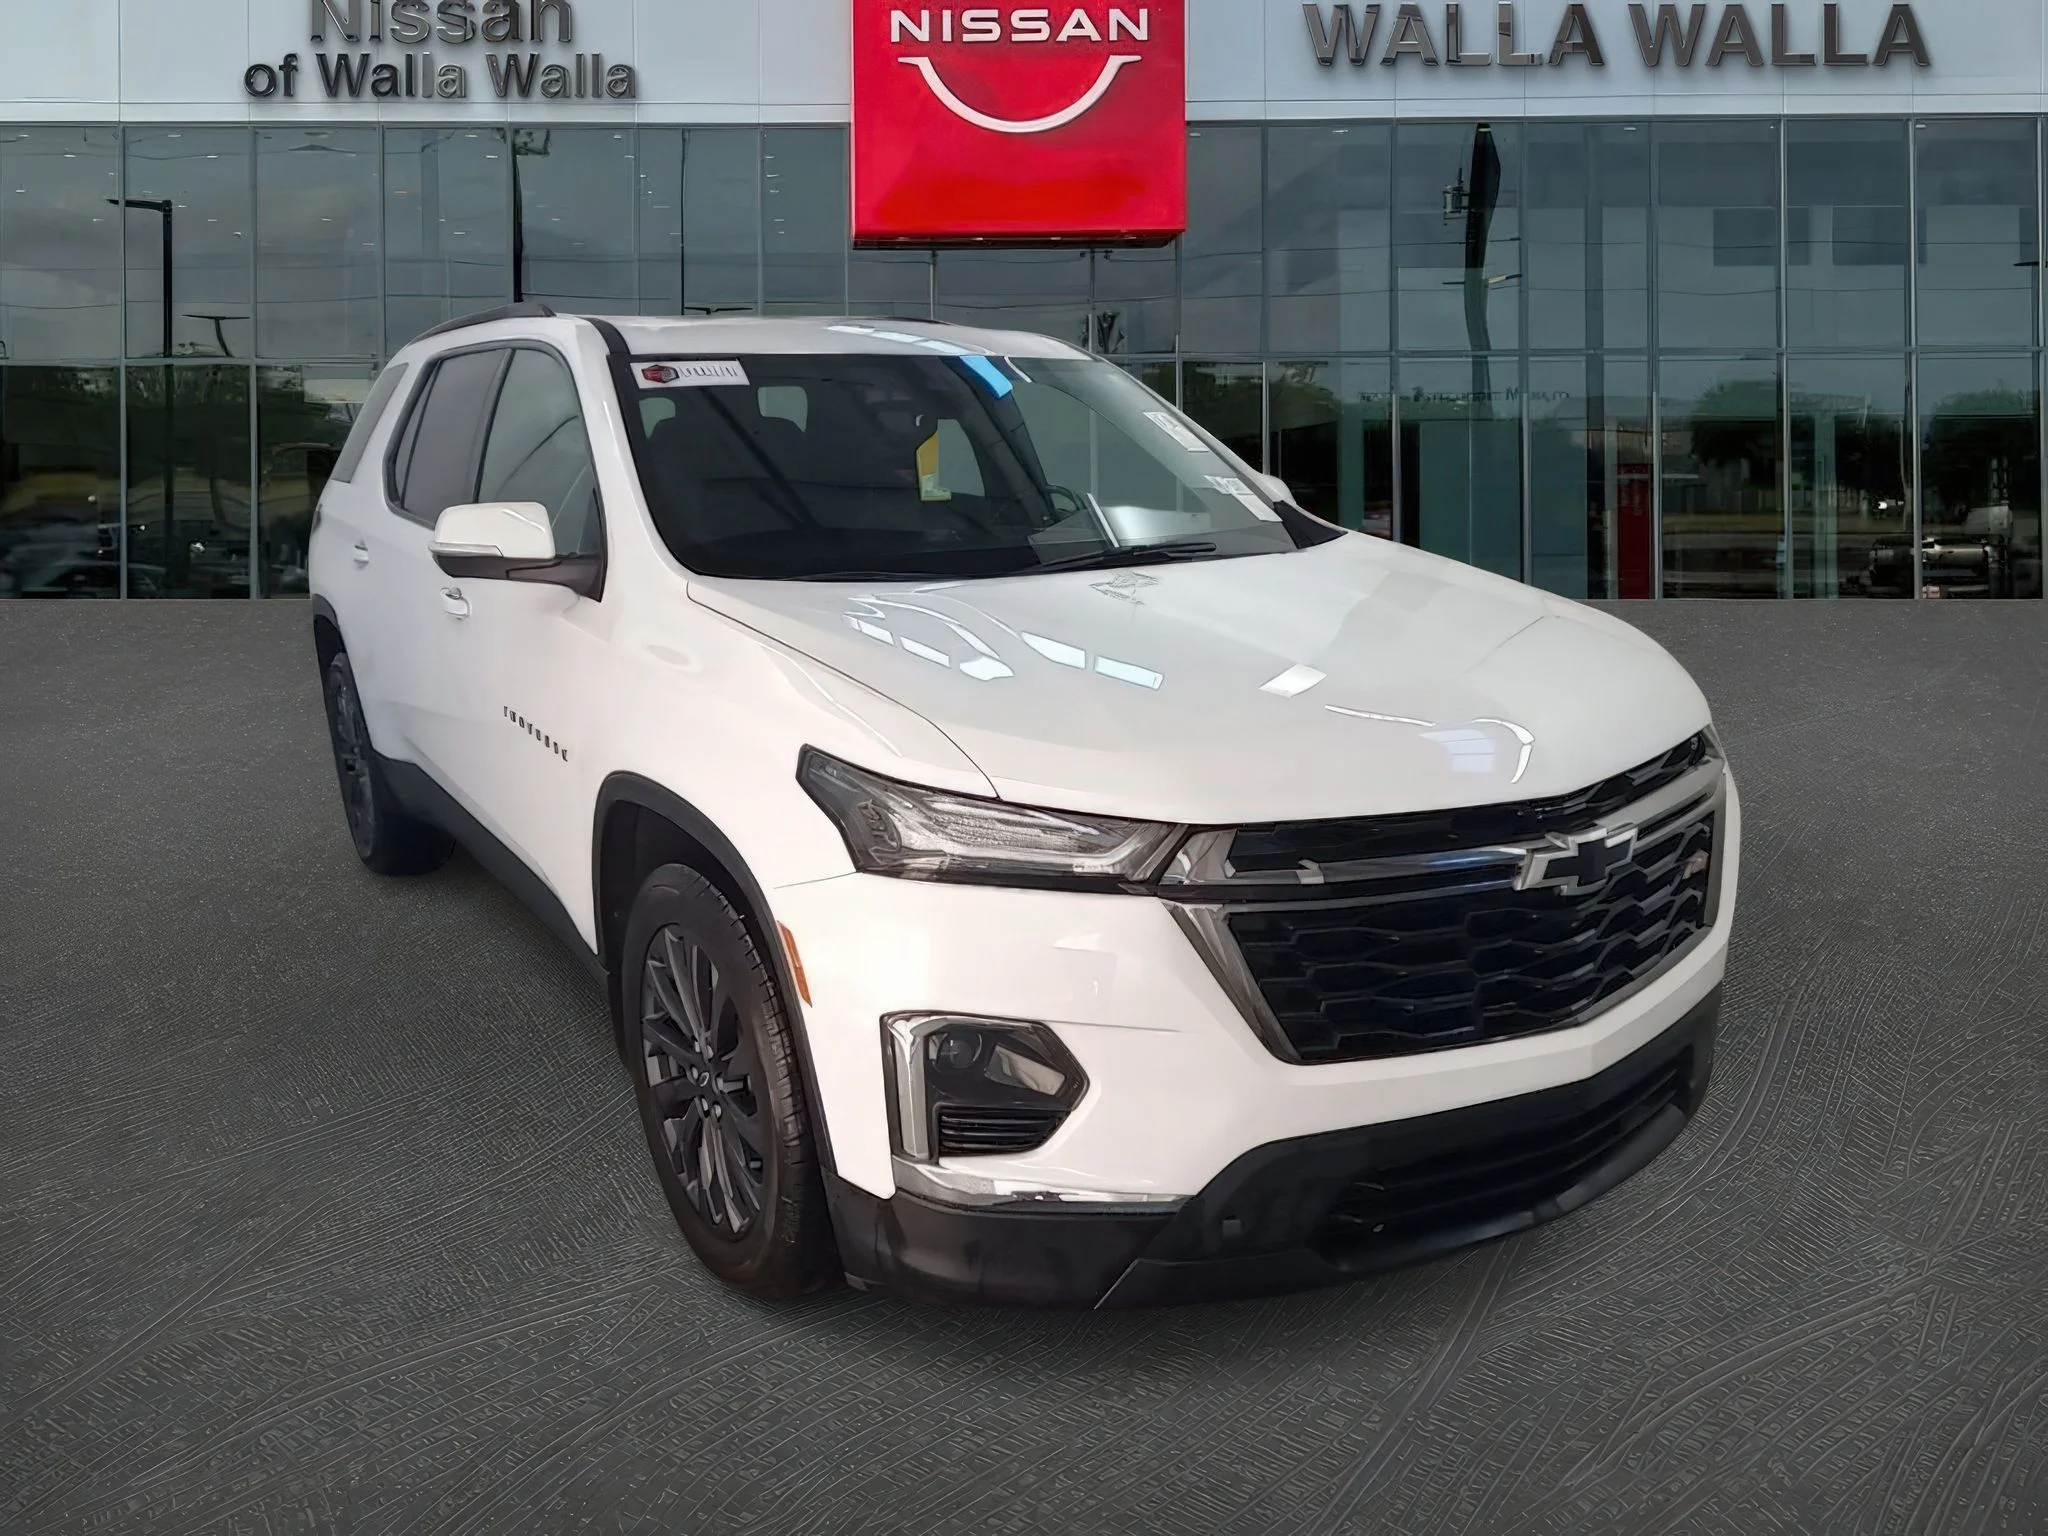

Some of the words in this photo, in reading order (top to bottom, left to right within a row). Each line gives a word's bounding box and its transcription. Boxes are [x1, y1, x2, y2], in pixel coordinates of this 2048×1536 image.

[310, 0, 573, 43] Nissan
[890, 8, 1149, 42] NISSAN
[1303, 3, 1605, 67] WALLA
[1627, 3, 1931, 67] WALLA
[243, 52, 299, 98] of
[315, 52, 467, 99] Walla
[485, 52, 637, 99] Walla
